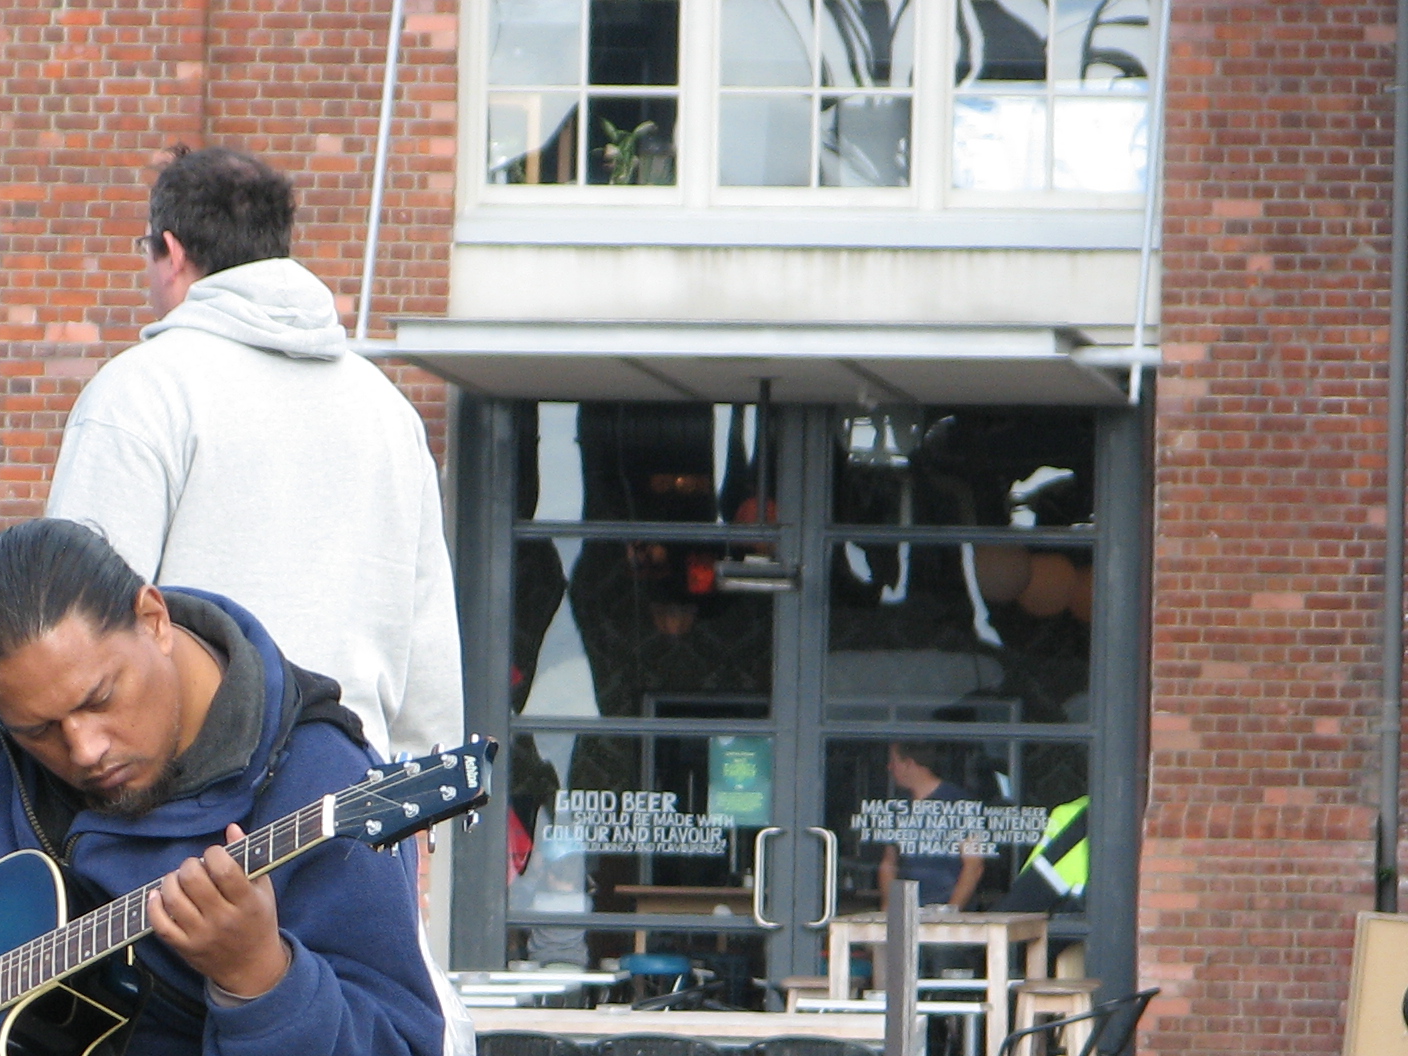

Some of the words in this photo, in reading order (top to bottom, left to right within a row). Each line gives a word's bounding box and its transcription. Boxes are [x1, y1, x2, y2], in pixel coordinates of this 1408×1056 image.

[555, 789, 616, 811] GOOD
[621, 791, 676, 812] BEER
[861, 799, 908, 814] MAC'S
[911, 800, 983, 816] BREWERY
[573, 811, 630, 825] SHOULD
[633, 812, 651, 826] BE
[653, 812, 694, 826] MADE
[696, 814, 735, 827] WITH
[850, 814, 869, 829] IN
[871, 814, 895, 829] THE
[896, 815, 925, 829] WAY
[925, 815, 986, 830] NATURE
[543, 825, 609, 842] COLOUR
[612, 826, 649, 842] AND
[653, 827, 727, 848] FLAVOUR,
[860, 828, 872, 841] IF
[873, 828, 919, 842] INDEED
[920, 829, 968, 843] NATURE
[968, 830, 991, 843] DID
[992, 830, 1040, 843] INTEND
[635, 842, 655, 853] AND
[898, 841, 917, 855] TO
[918, 841, 960, 856] MAKE
[962, 842, 1000, 856] BEER.
